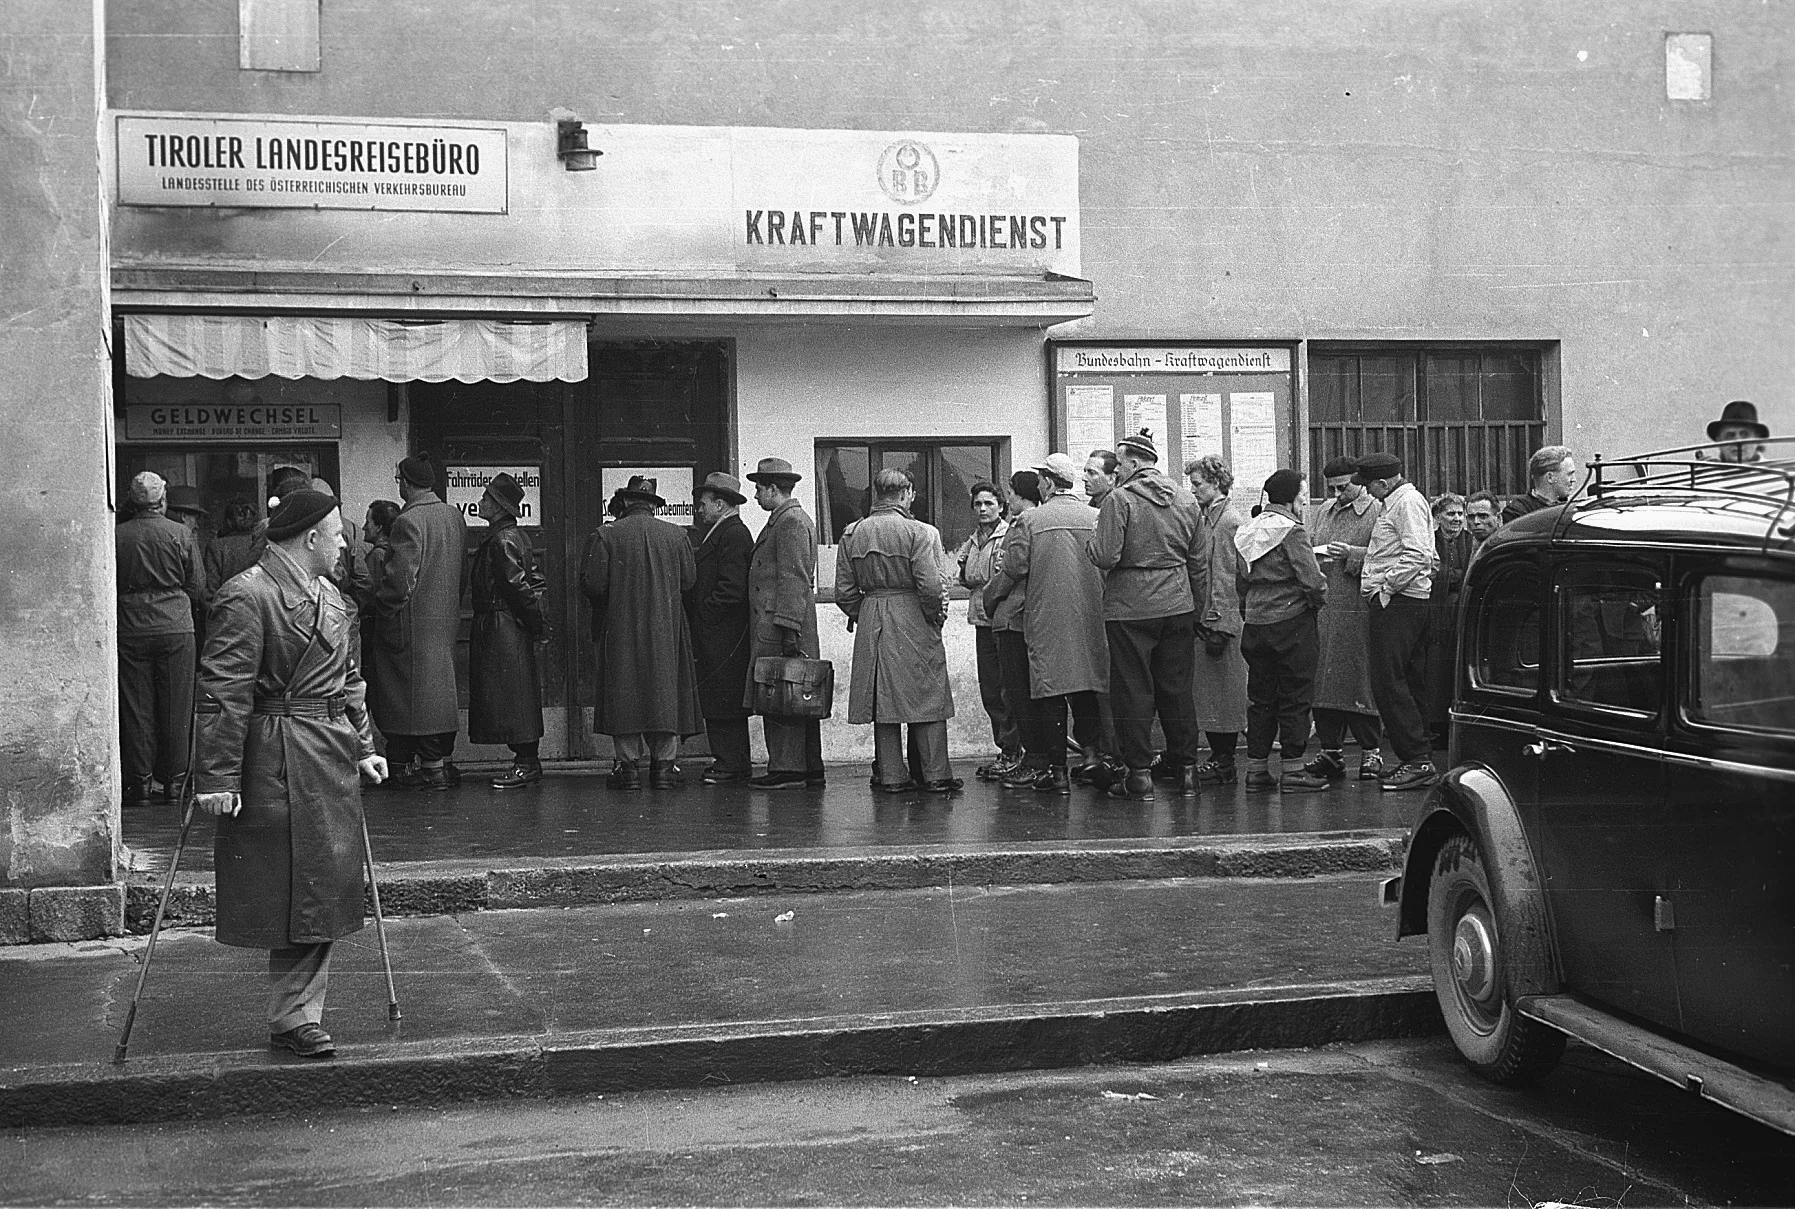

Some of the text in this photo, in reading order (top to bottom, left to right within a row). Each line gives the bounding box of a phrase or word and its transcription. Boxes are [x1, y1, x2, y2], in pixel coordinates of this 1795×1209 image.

[145, 134, 480, 176] TIROLER LANDESREISEBÜRO
[162, 176, 466, 197] LANDESSTELLE DES ÖSTERREICHISCHEN VERKEHRSBUREAU
[745, 209, 1067, 249] KRAFTWAGENDIENST
[1075, 352, 1151, 368] Bundesbahn
[151, 408, 320, 424] GELDWECHSEL
